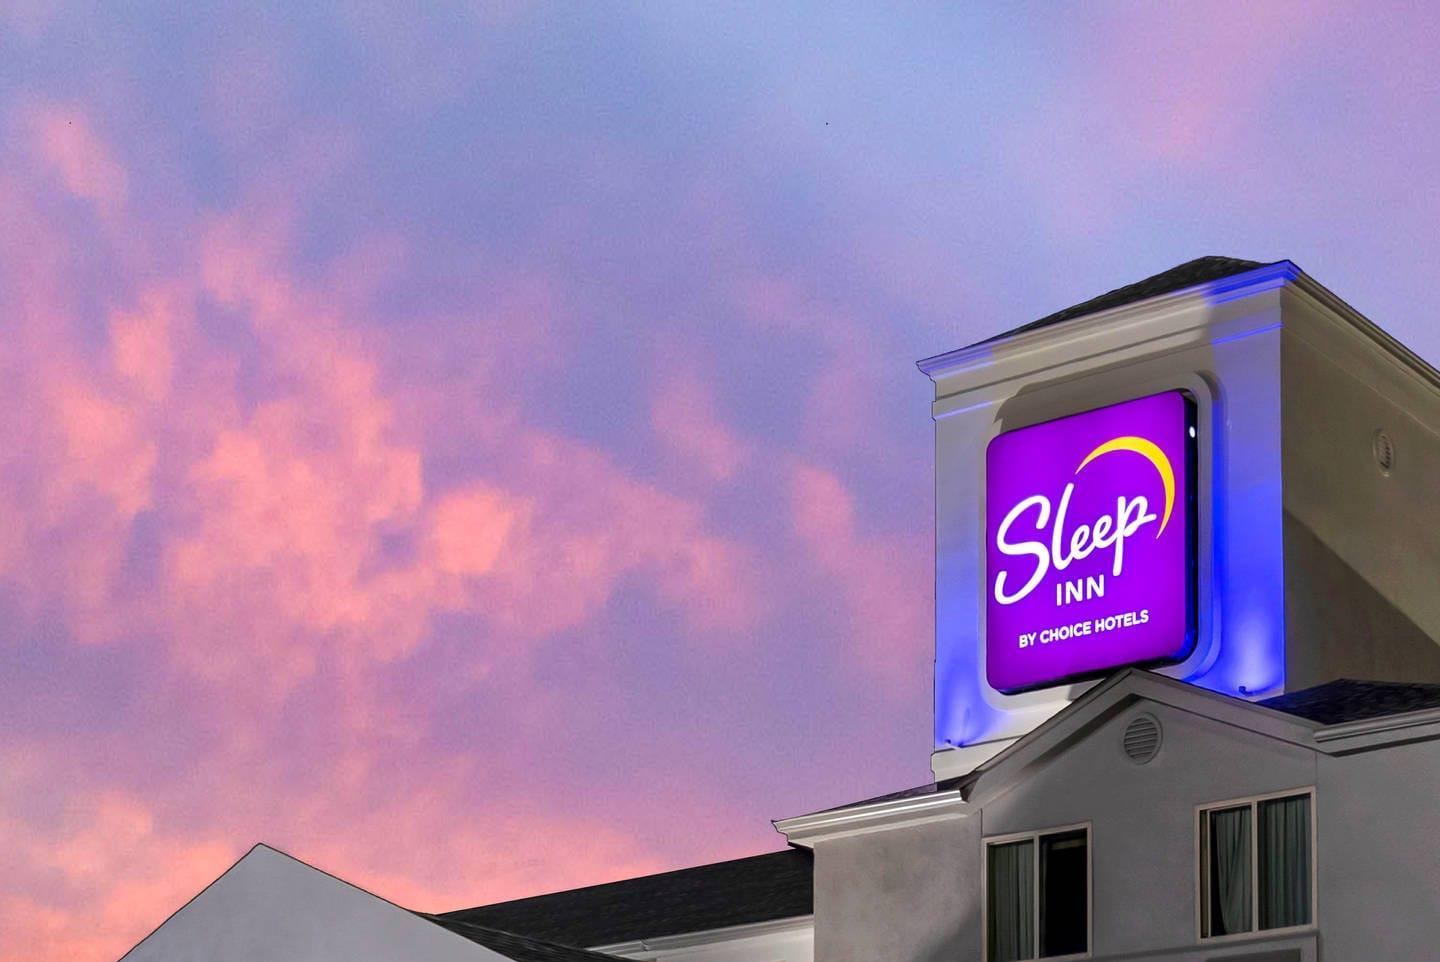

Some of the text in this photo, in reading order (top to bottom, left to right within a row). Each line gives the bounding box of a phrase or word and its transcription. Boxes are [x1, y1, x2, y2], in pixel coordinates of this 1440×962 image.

[994, 482, 1157, 605] Sleep
[1056, 574, 1105, 606] INN
[1019, 609, 1150, 649] BY CHOICE HOTELS
